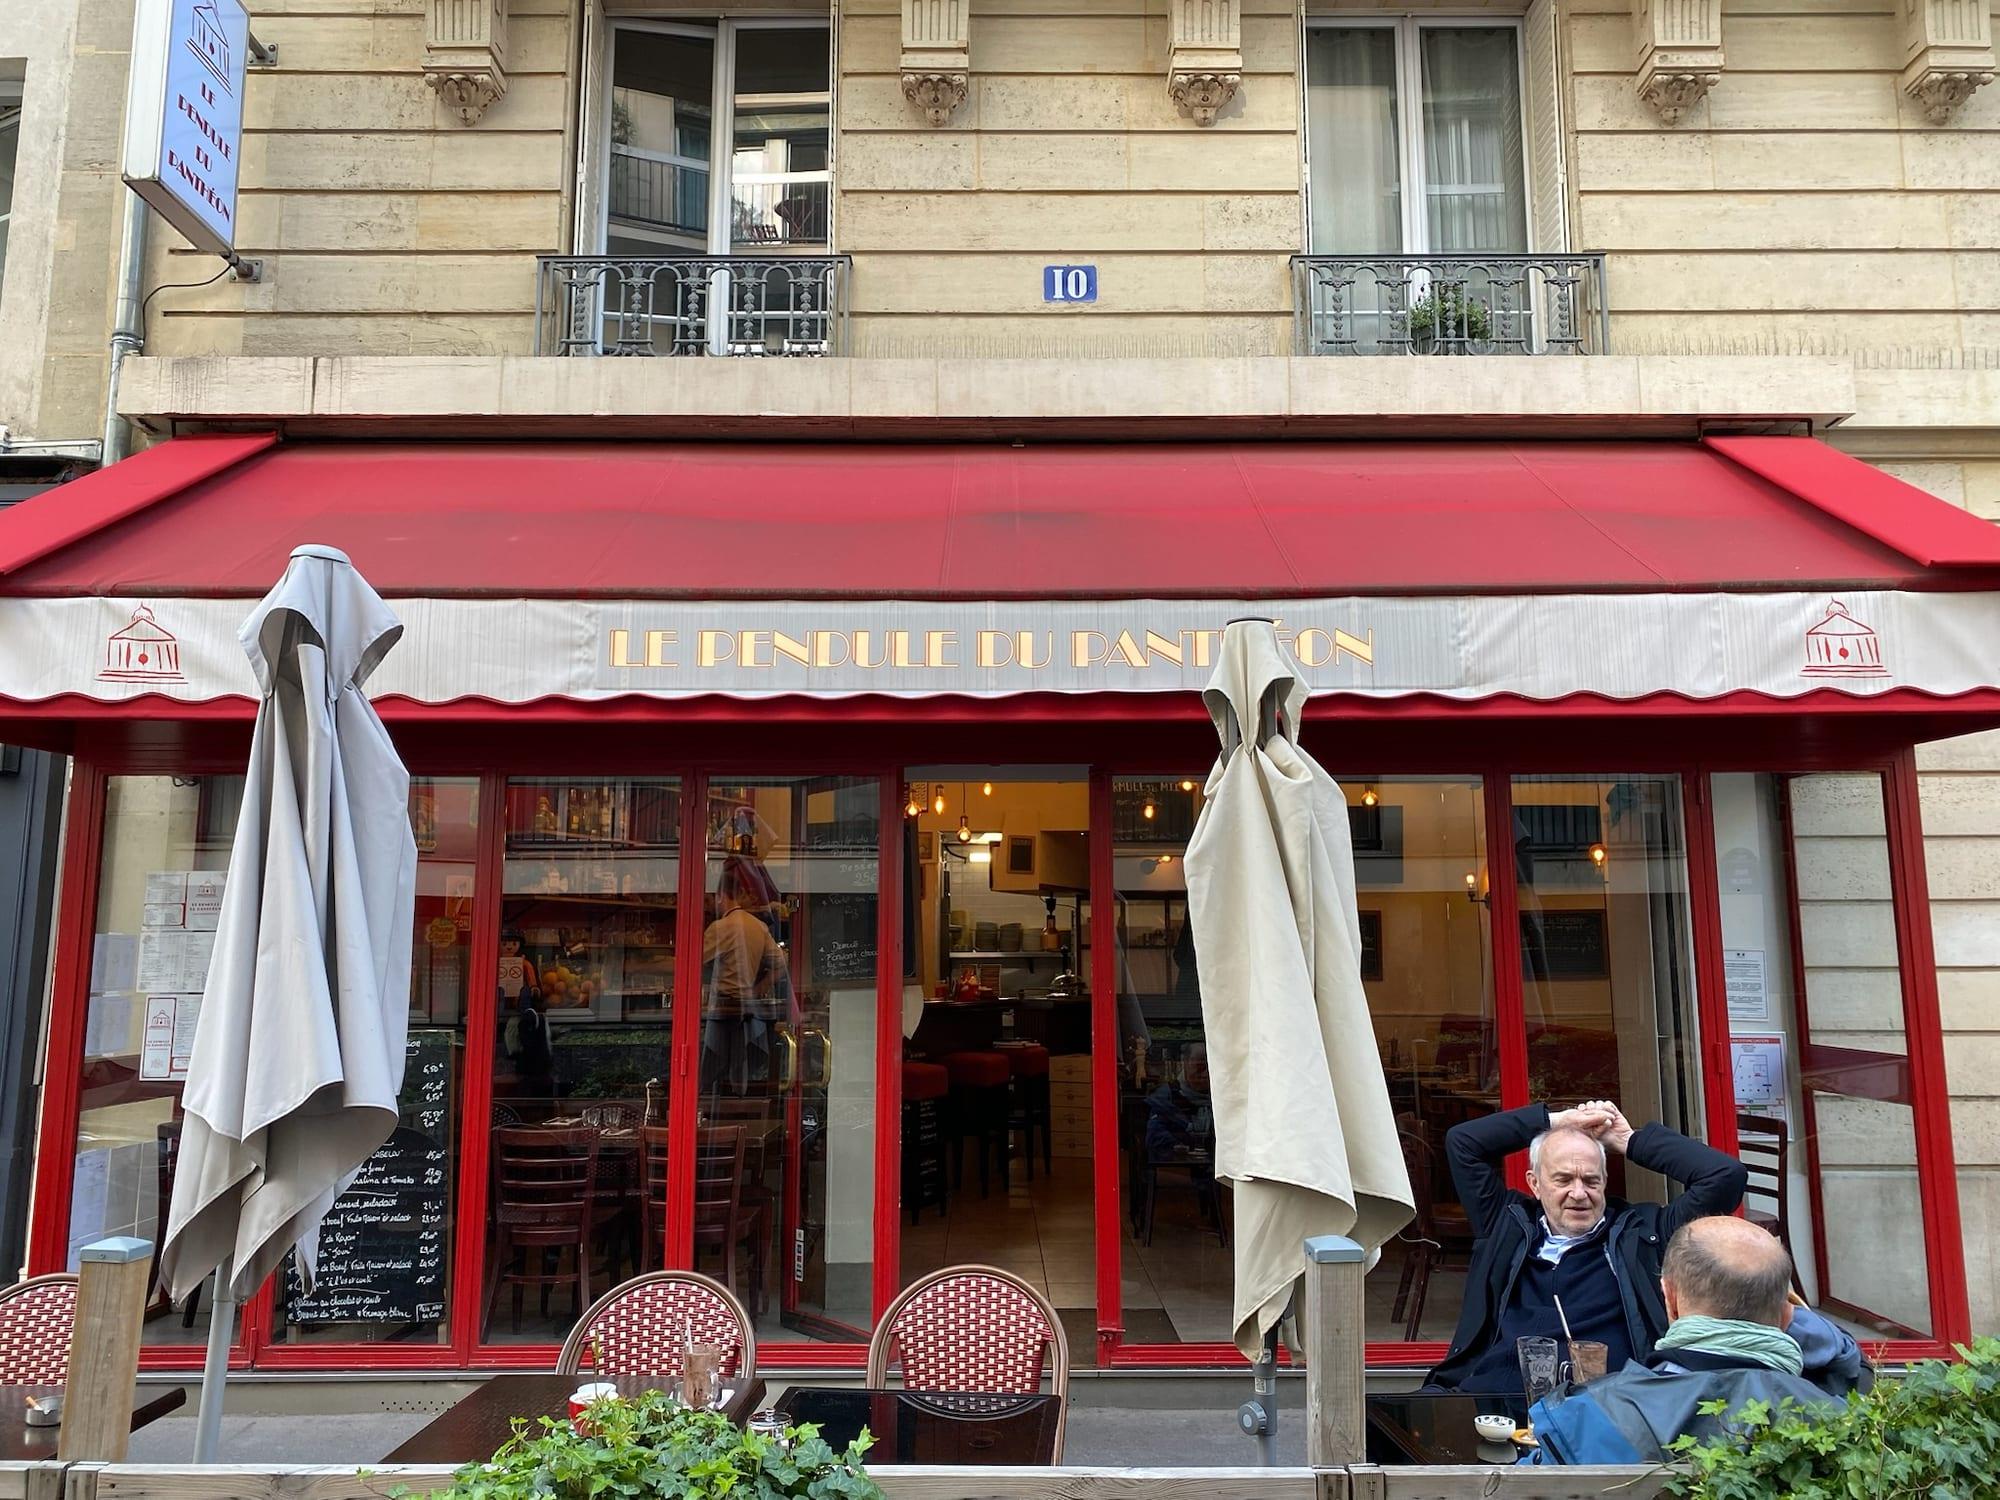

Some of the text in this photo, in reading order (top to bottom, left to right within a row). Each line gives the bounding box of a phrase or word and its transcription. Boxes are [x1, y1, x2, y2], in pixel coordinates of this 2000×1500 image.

[201, 81, 216, 109] LE
[178, 93, 232, 163] PENDULE
[195, 144, 213, 172] DU
[168, 149, 231, 222] PANTHÉON
[1053, 269, 1088, 298] 10
[609, 618, 1374, 669] LE PENDULE DU PANTON
